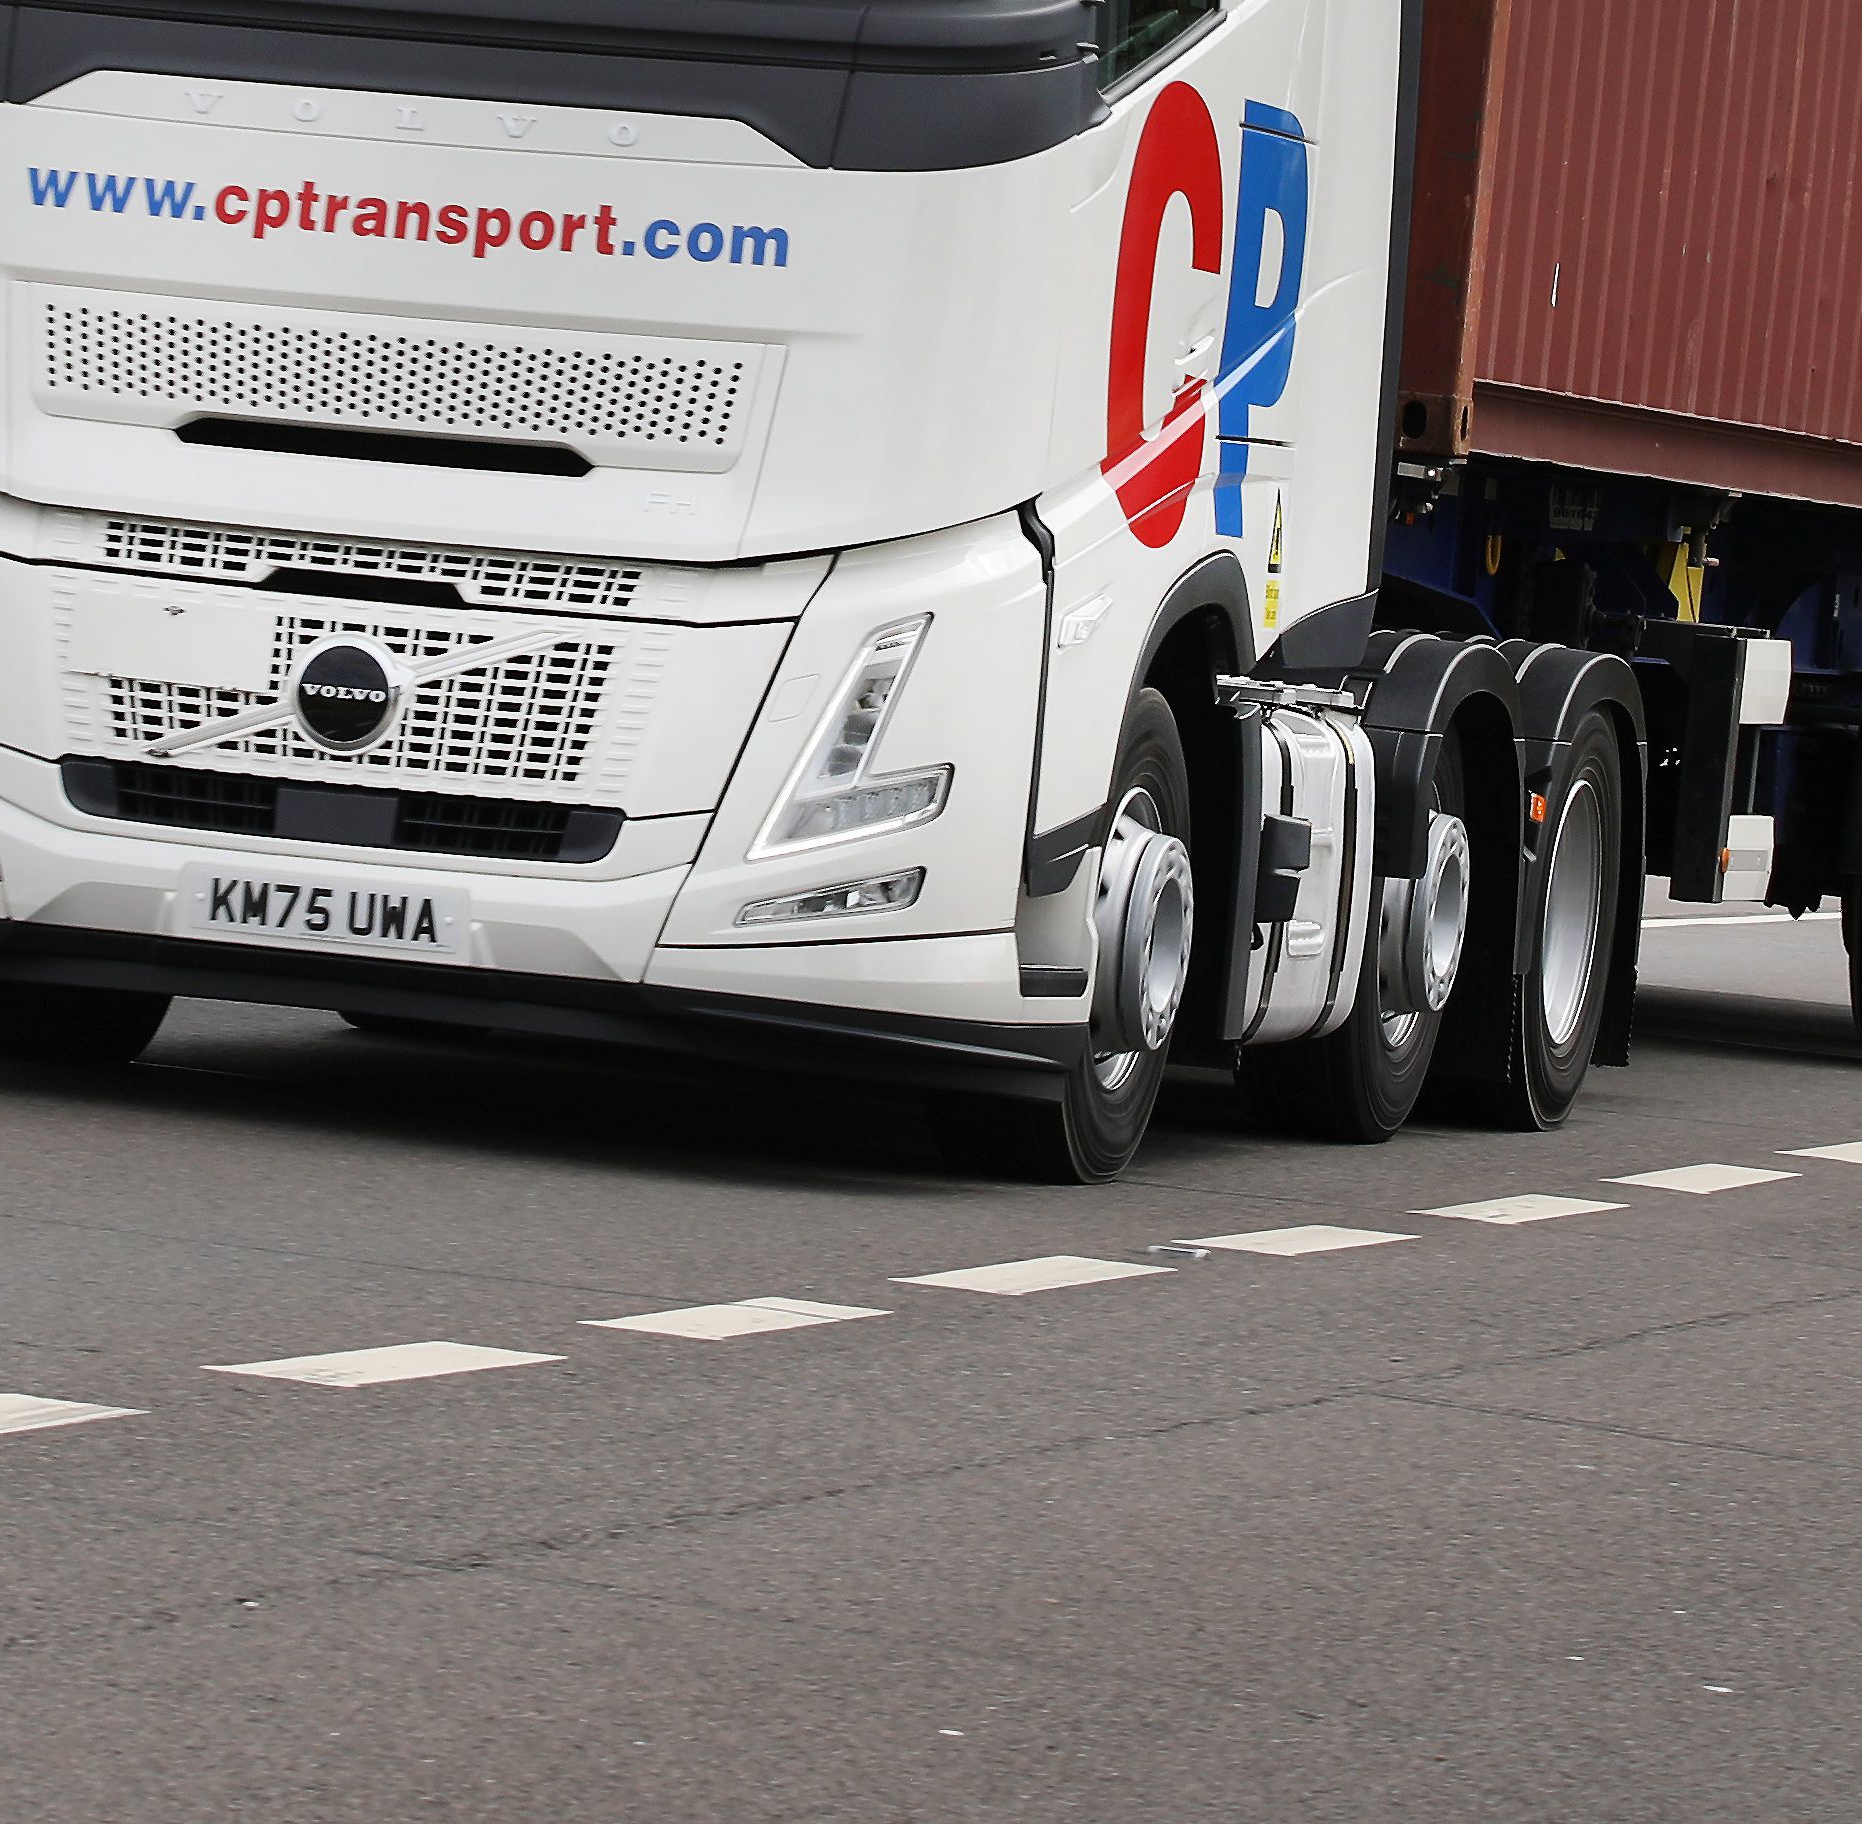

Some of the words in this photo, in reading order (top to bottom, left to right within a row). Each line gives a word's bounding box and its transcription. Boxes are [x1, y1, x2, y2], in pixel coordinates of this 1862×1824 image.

[185, 91, 641, 147] VOLVO
[27, 167, 789, 268] www.cptransport.com
[1100, 80, 1308, 548] CP
[302, 683, 387, 703] VOLVO
[210, 877, 334, 932] KM75
[348, 891, 438, 944] UWA
